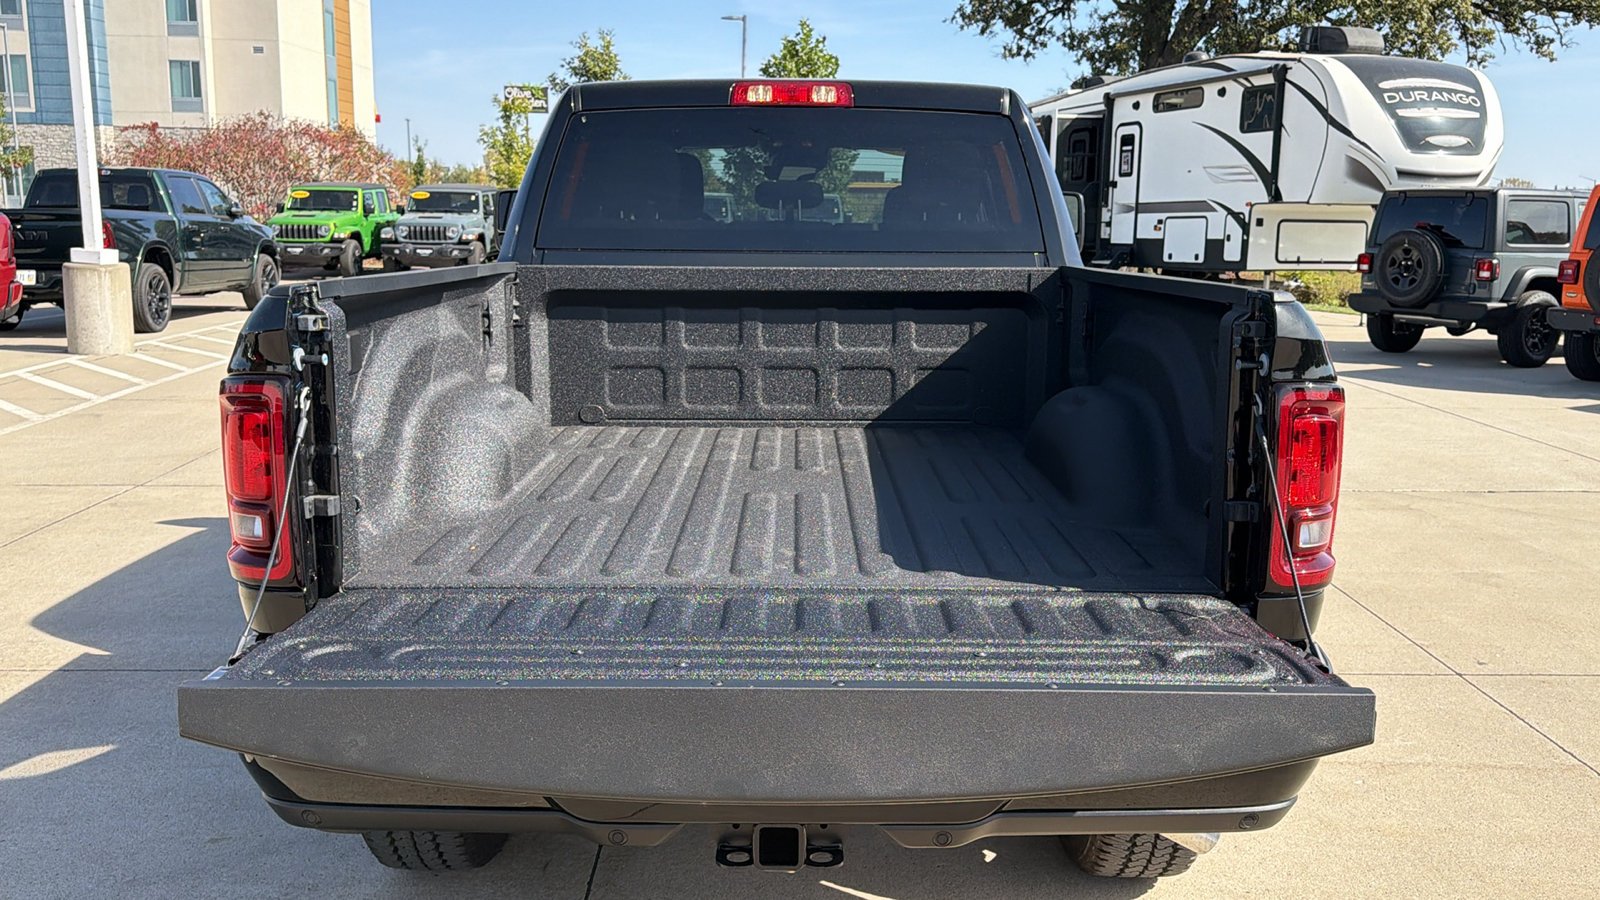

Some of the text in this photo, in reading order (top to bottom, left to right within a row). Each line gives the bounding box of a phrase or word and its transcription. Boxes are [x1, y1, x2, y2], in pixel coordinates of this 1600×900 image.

[505, 87, 532, 98] Olive
[509, 97, 547, 108] Gden
[1383, 90, 1481, 107] DURANGO
